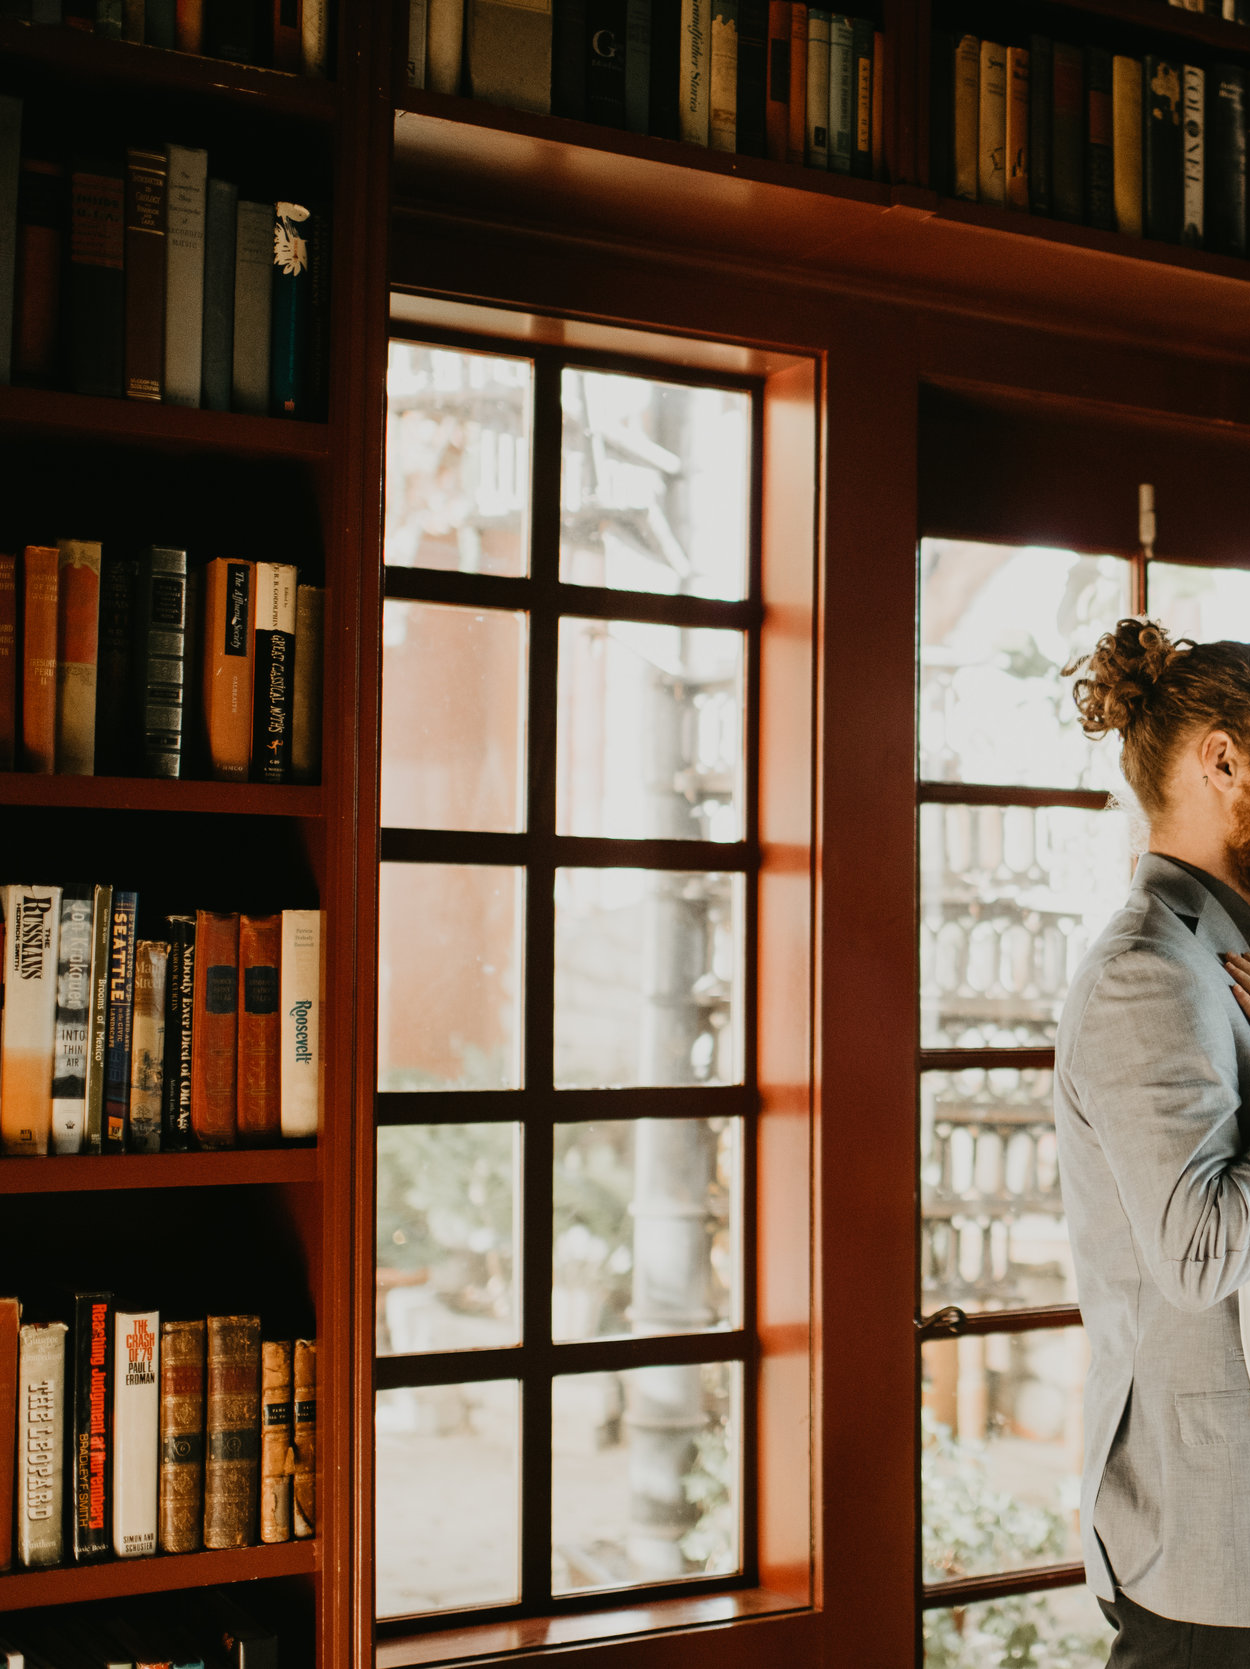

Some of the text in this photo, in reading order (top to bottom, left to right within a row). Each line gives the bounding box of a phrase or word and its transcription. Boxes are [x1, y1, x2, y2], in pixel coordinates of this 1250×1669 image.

[592, 28, 617, 58] G
[230, 571, 247, 649] The Affluent Society
[268, 634, 286, 734] GREAT CLASSICAL MYTHS
[21, 896, 52, 979] RUSSIANS
[67, 901, 91, 1008] Jon Krakauer
[110, 913, 128, 1001] SEATTLE
[125, 913, 136, 1002] STIRRING UP
[62, 1030, 86, 1041] INTO
[96, 1015, 105, 1025] of
[290, 1000, 313, 1064] Roosevelt
[63, 1045, 83, 1055] THIN
[177, 943, 195, 1132] Nobody Ever Died of Old Age
[66, 1058, 80, 1067] AIR
[126, 1333, 155, 1348] CRASH
[133, 1319, 148, 1334] THE
[128, 1361, 154, 1373] PAUL E.
[129, 1347, 153, 1362] OF '79
[126, 1373, 155, 1386] ERDMAN
[88, 1303, 107, 1529] Reaching Judgment at Nuremberg
[27, 1380, 54, 1521] THE LEOPARD
[79, 1434, 89, 1482] BRADLEY
[78, 1494, 89, 1527] SMITH
[123, 1533, 154, 1543] SIMON AND
[125, 1543, 153, 1552] SCHUSTER
